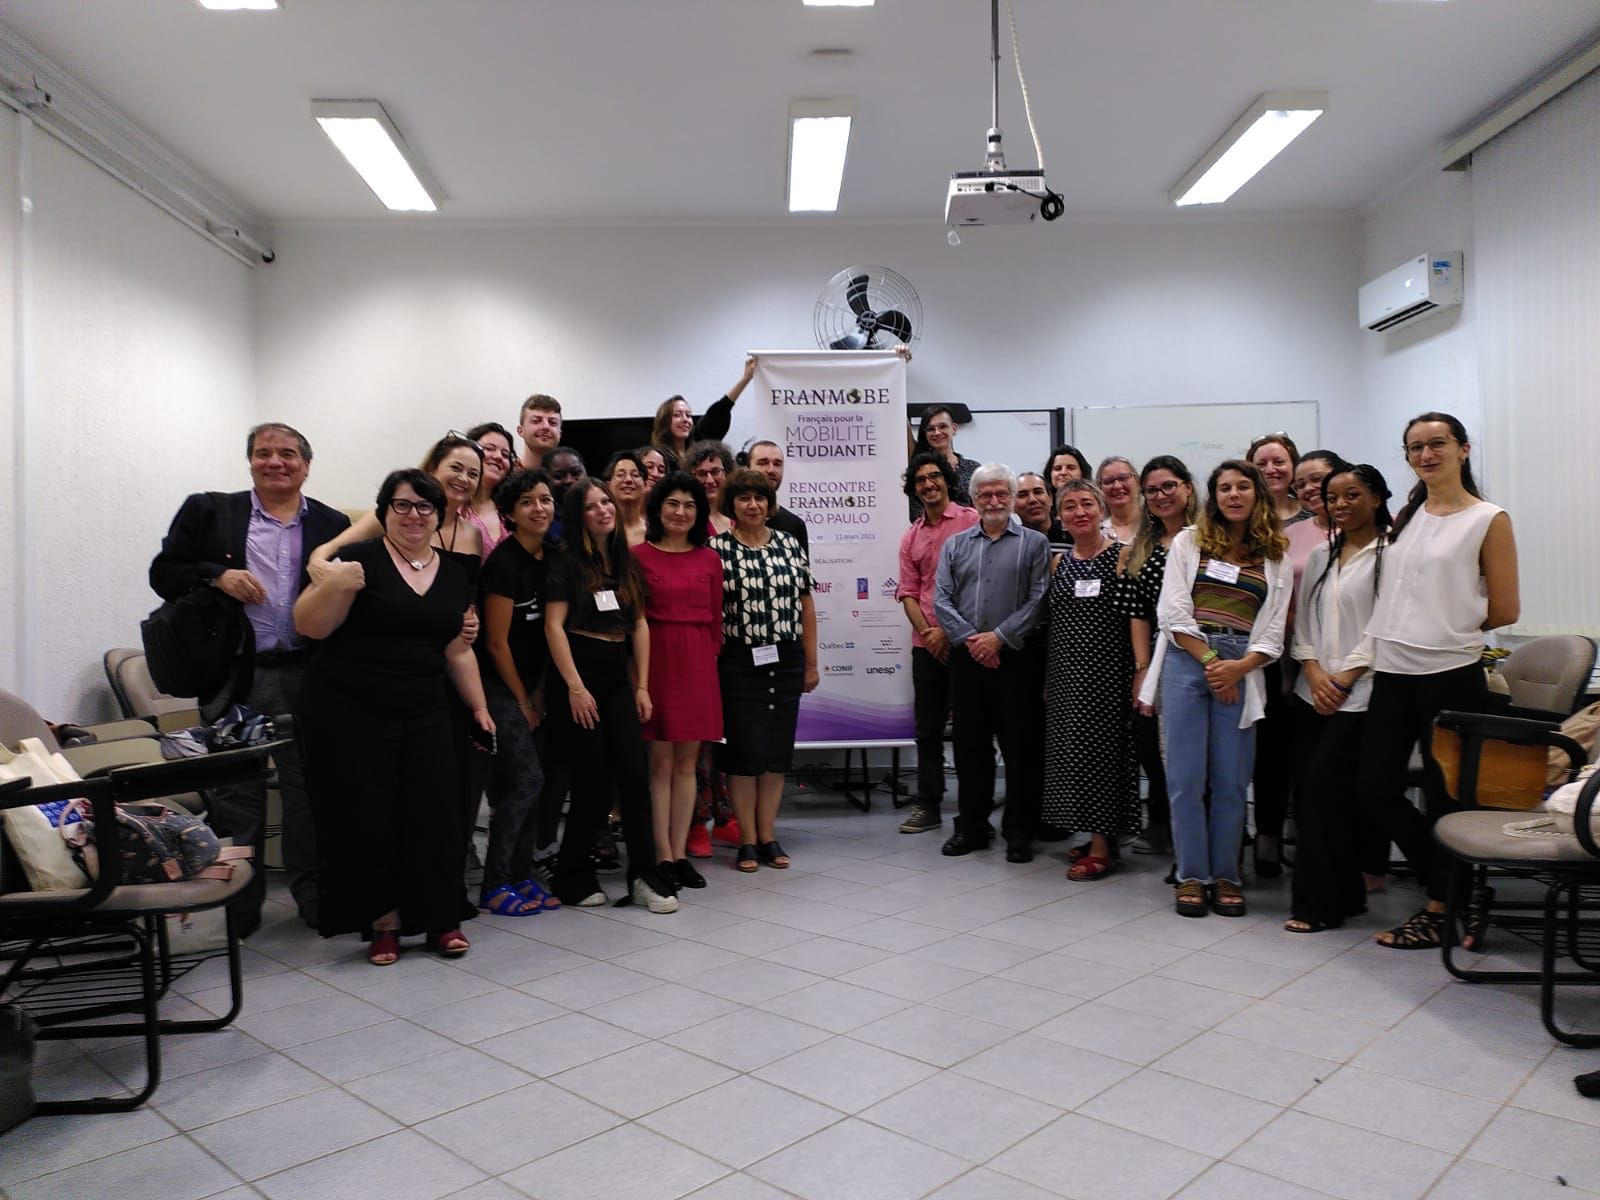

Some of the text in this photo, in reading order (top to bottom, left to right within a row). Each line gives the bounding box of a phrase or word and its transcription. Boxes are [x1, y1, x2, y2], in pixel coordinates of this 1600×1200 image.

[797, 414, 864, 424] Français pour la
[785, 421, 877, 442] MOBILITÉ
[786, 442, 877, 458] ÉTUDIANTE
[789, 481, 876, 493] RENCONTRE
[827, 512, 870, 524] PAULO
[866, 666, 896, 676] unesp
